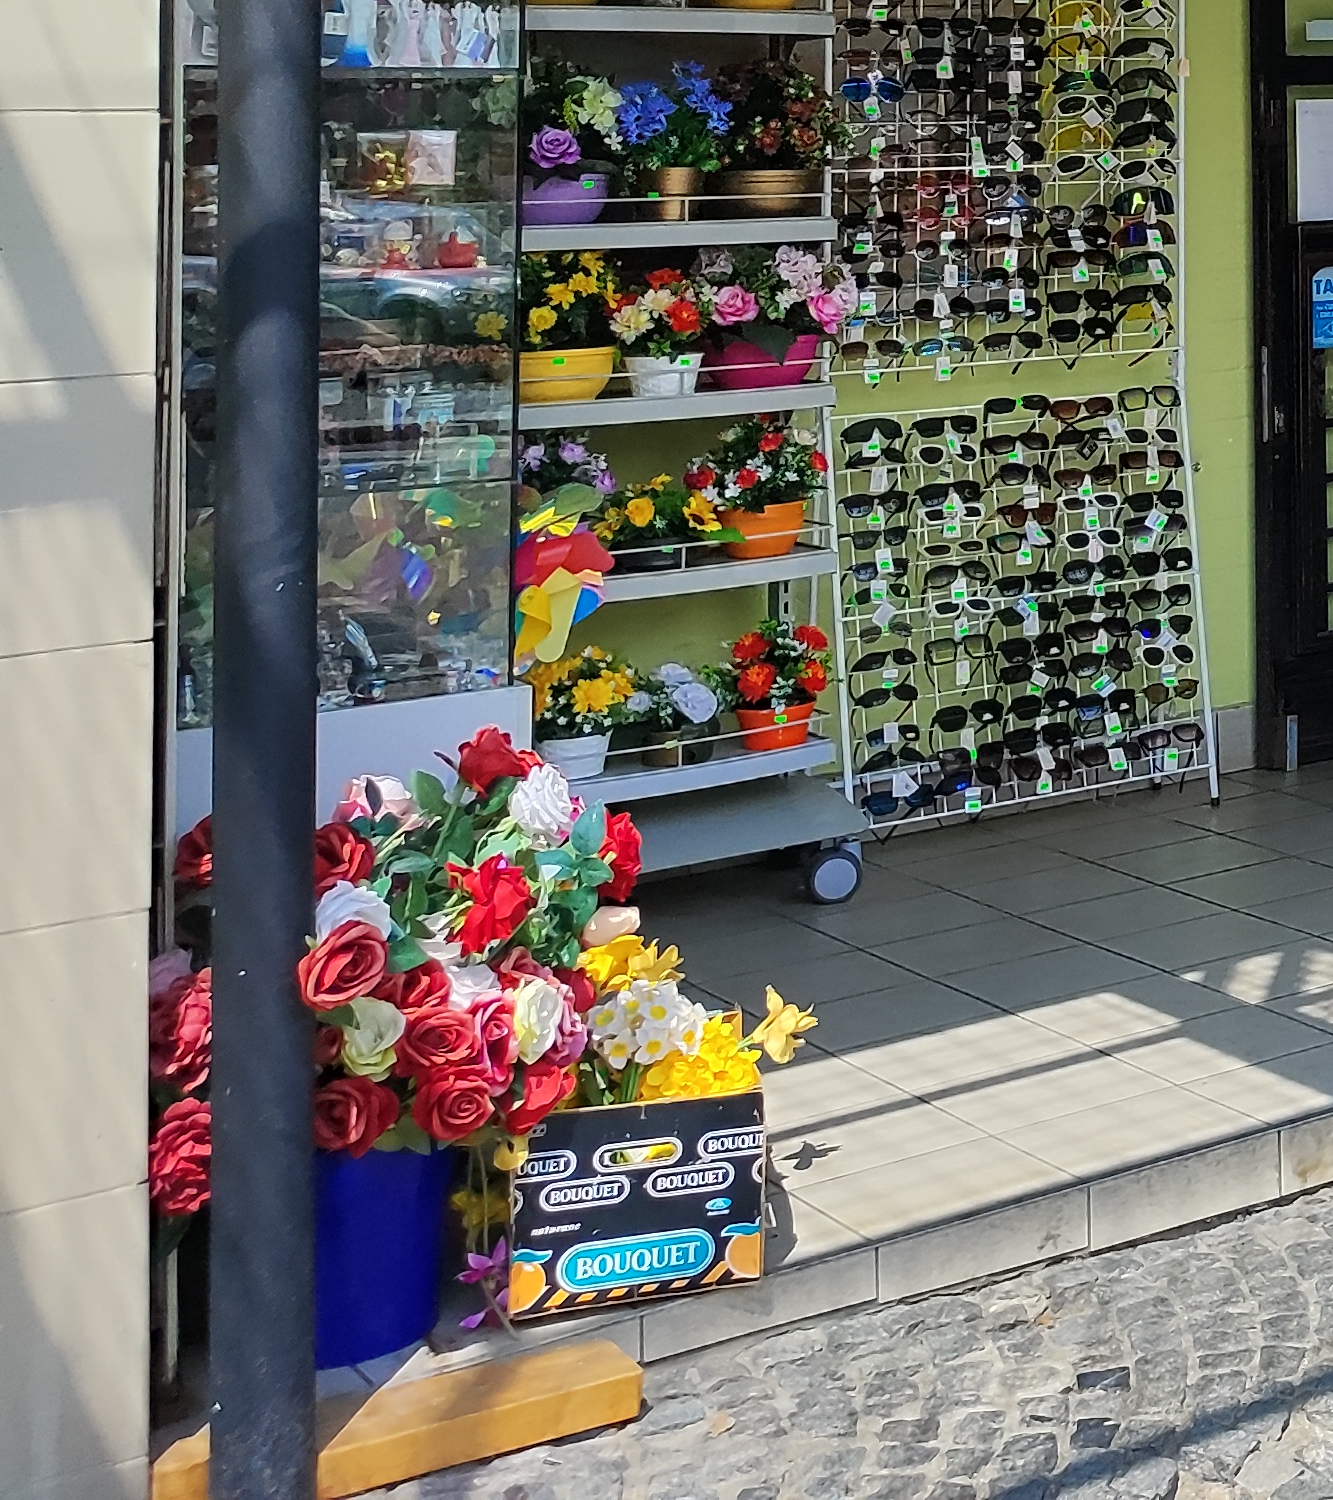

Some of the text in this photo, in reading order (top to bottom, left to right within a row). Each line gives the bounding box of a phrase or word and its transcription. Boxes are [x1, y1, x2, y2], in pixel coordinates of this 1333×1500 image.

[707, 1132, 764, 1152] BOUQU
[517, 1157, 568, 1175] UQUET
[656, 1169, 726, 1190] BOUQUET
[549, 1184, 623, 1204] BOUQUET
[574, 1241, 702, 1280] BOUQUET
